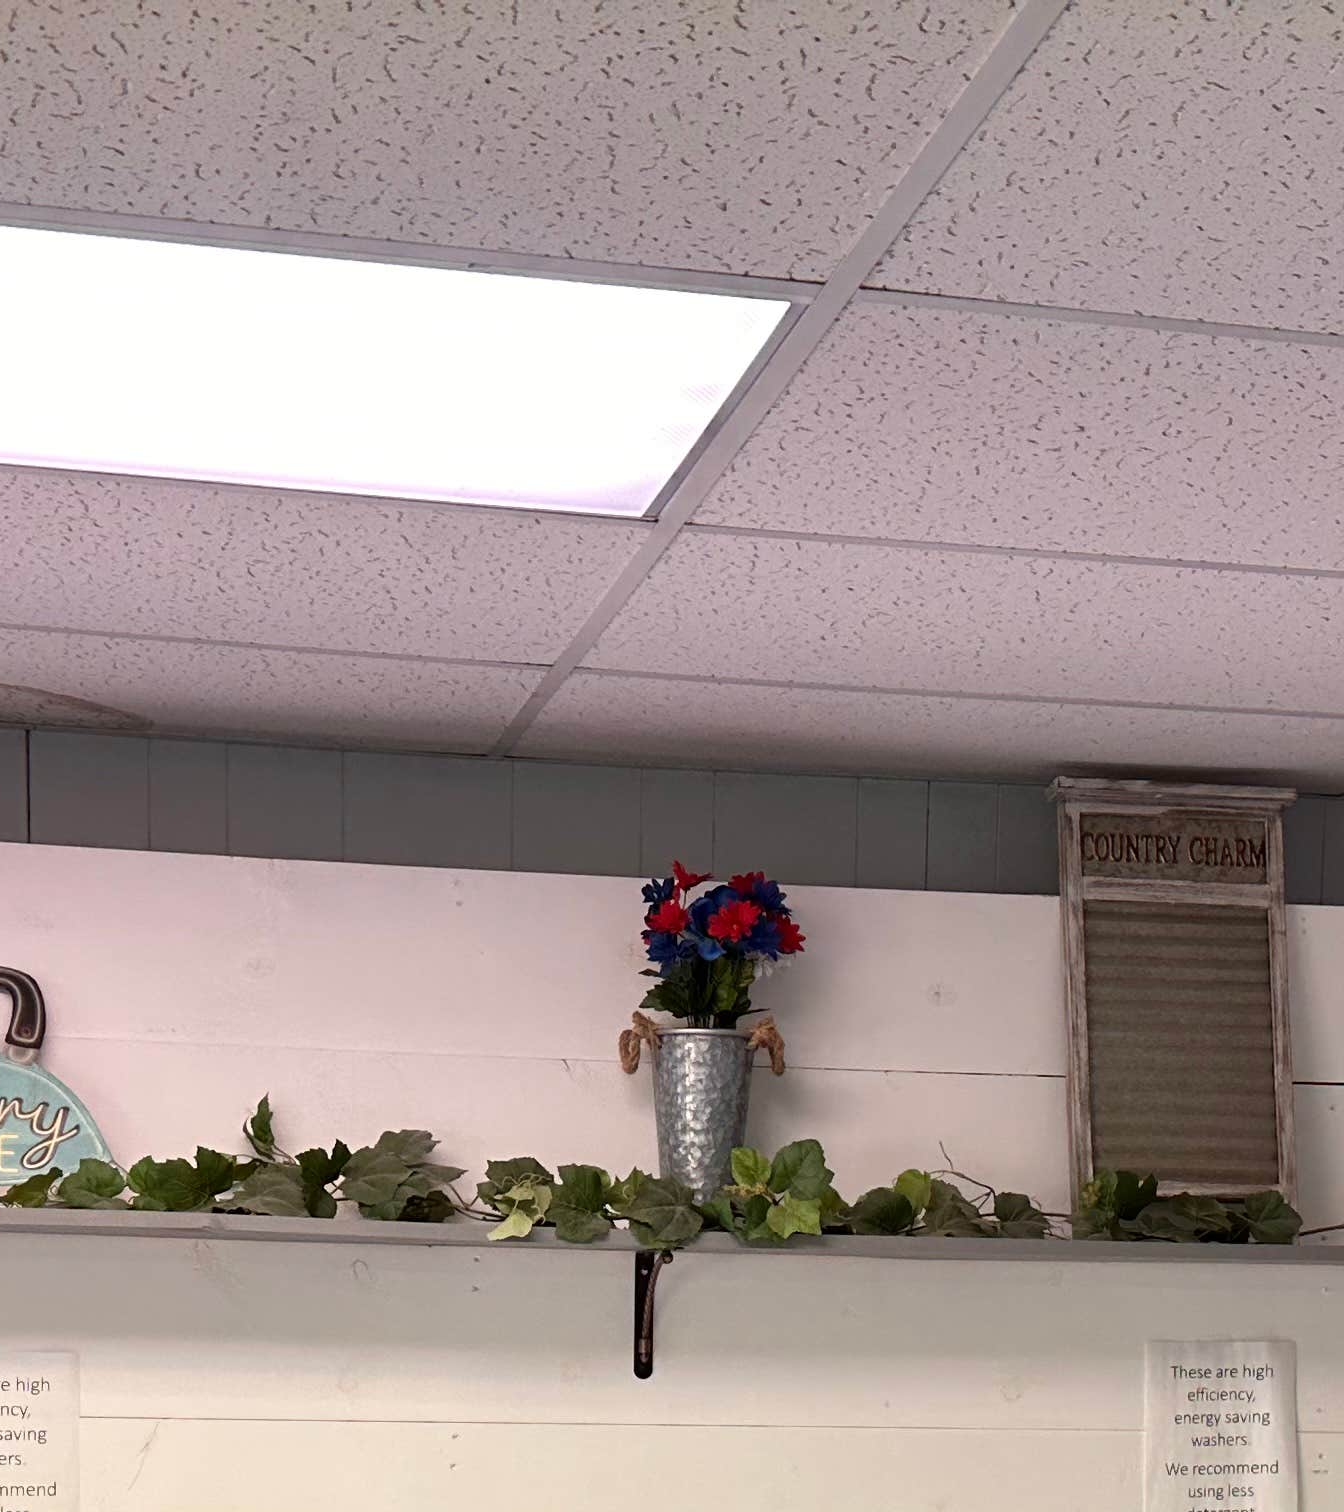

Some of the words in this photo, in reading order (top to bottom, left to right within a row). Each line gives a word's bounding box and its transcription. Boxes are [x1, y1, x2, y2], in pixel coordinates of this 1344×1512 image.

[1080, 832, 1181, 864] COUNTRY
[1189, 836, 1267, 867] CHARM
[1171, 1365, 1212, 1379] These
[1216, 1367, 1238, 1379] are
[1243, 1364, 1274, 1381] high
[16, 1376, 51, 1395] high
[1187, 1387, 1256, 1404] efficiency,
[1174, 1413, 1221, 1428] energy
[1225, 1411, 1270, 1426] saving
[1165, 1463, 1189, 1477] We
[1192, 1459, 1279, 1476] recommend
[1188, 1486, 1224, 1501] using
[1228, 1484, 1255, 1498] less
